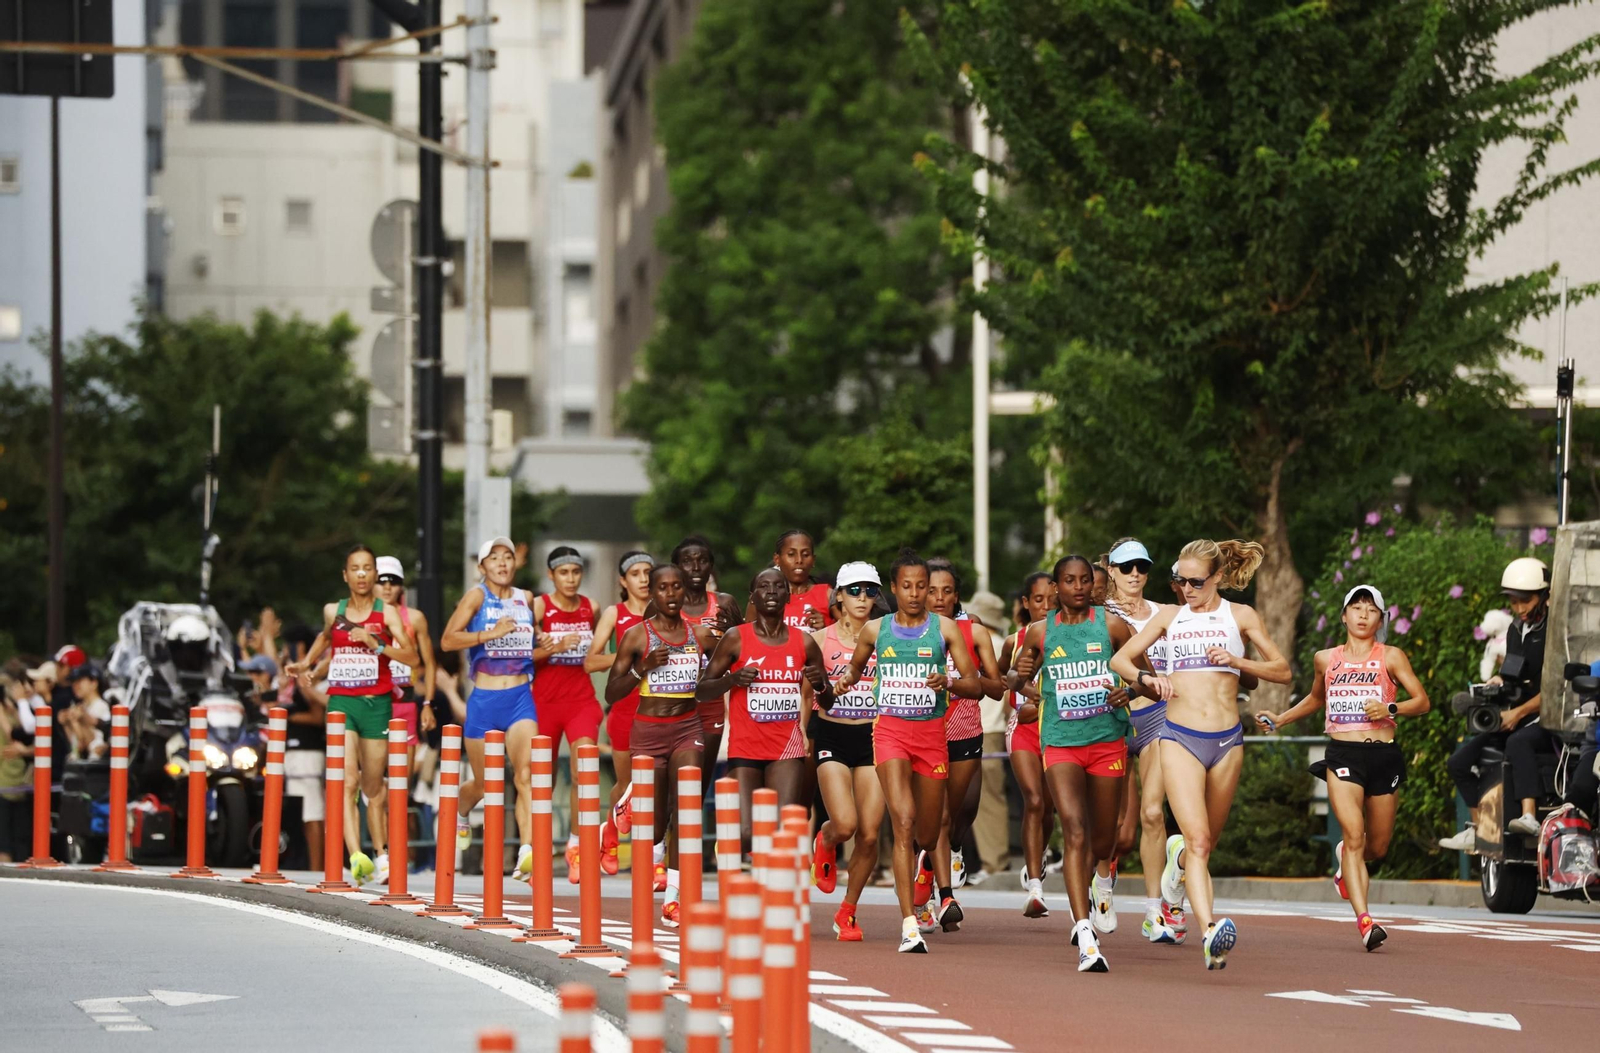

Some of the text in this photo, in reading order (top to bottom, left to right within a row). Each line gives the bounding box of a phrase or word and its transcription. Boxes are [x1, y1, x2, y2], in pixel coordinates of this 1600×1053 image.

[1172, 630, 1228, 640] HONDA
[332, 668, 376, 679] GARDADI
[880, 663, 938, 679] ETHIOPIA
[1047, 659, 1110, 680] ETHIOPIA
[650, 669, 697, 683] CHESANG
[1330, 672, 1377, 685] JAPAN
[881, 680, 927, 689] HOND
[1057, 678, 1113, 690] HONDA
[749, 686, 799, 695] HONDA
[1329, 689, 1380, 697] HONDA
[750, 699, 798, 711] CHUMBA
[834, 695, 876, 707] ANDO
[882, 693, 932, 706] KETEMA
[1329, 701, 1365, 713] KOBAYA
